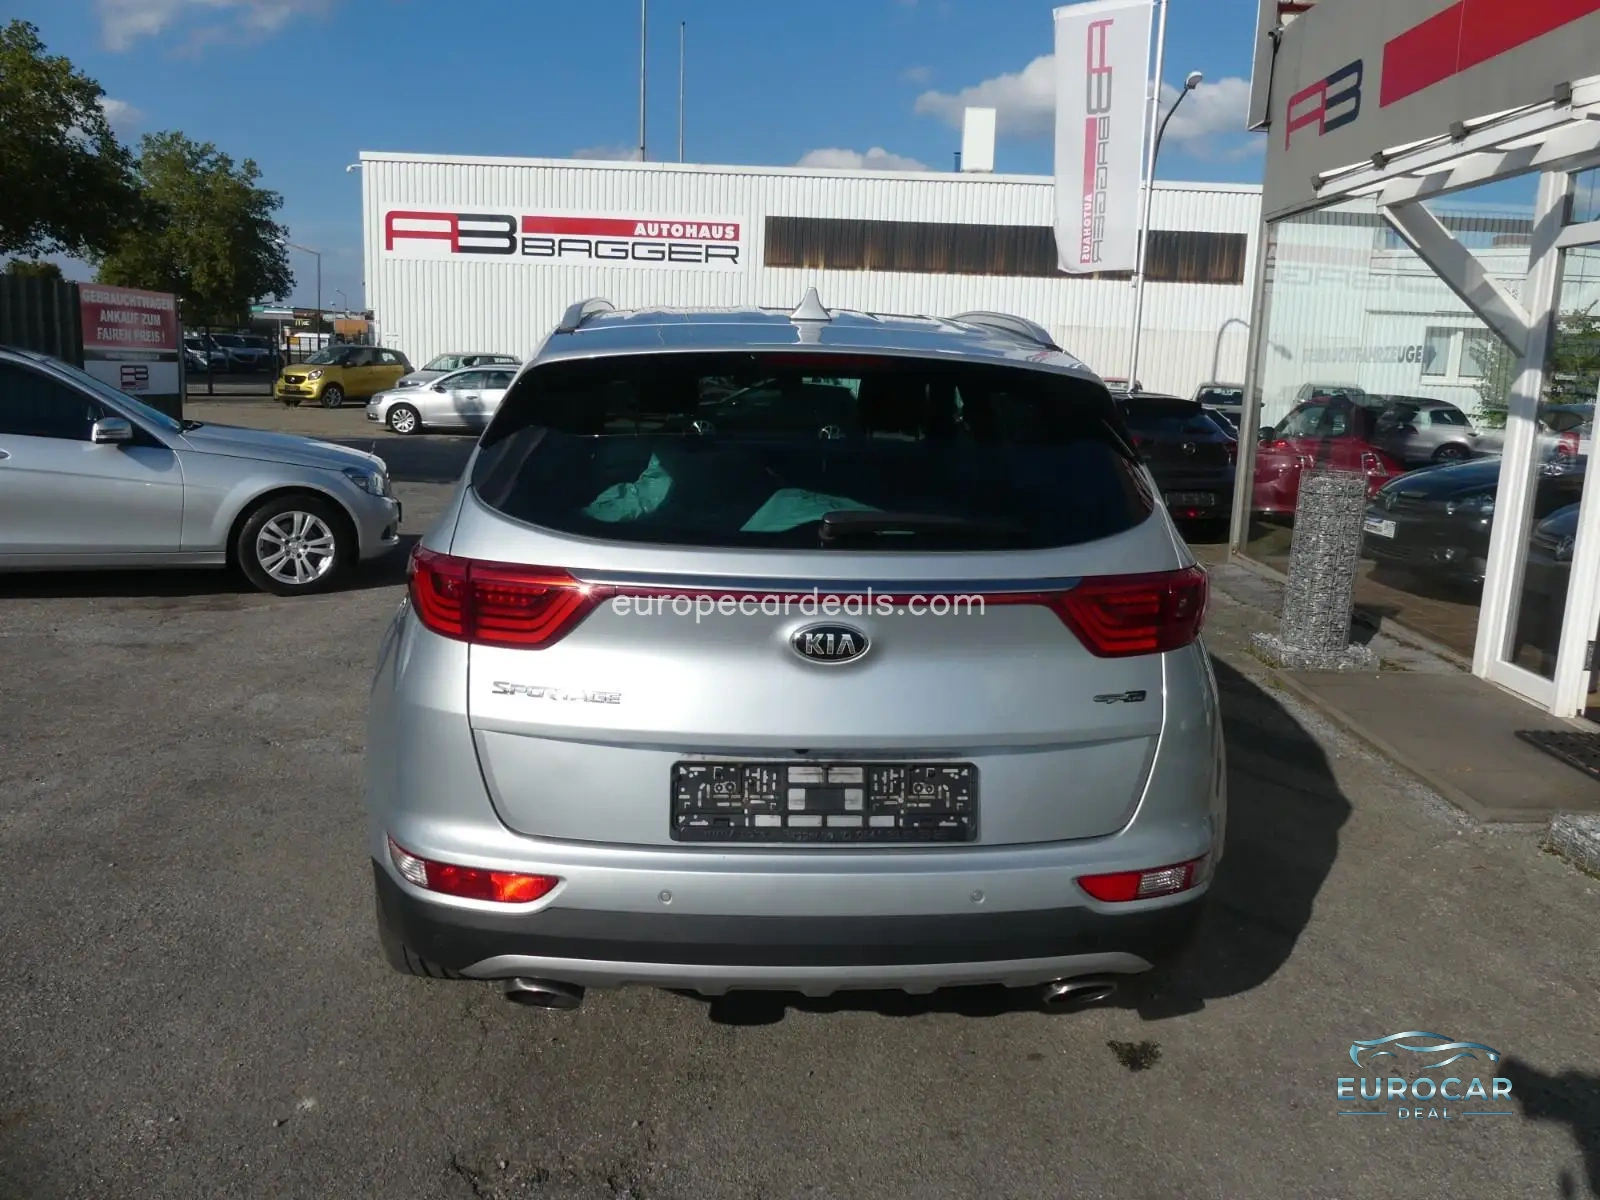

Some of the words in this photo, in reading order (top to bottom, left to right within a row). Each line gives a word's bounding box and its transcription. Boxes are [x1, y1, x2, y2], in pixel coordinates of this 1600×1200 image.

[633, 221, 738, 241] AUTOHAUS
[521, 237, 740, 265] BAGGER
[81, 289, 174, 311] GEBRAUCHTWAGEN
[100, 309, 138, 325] ANKAUF
[142, 313, 161, 326] ZUM
[97, 327, 131, 342] FAIREN
[133, 329, 160, 343] PREIS
[805, 633, 856, 655] KIA
